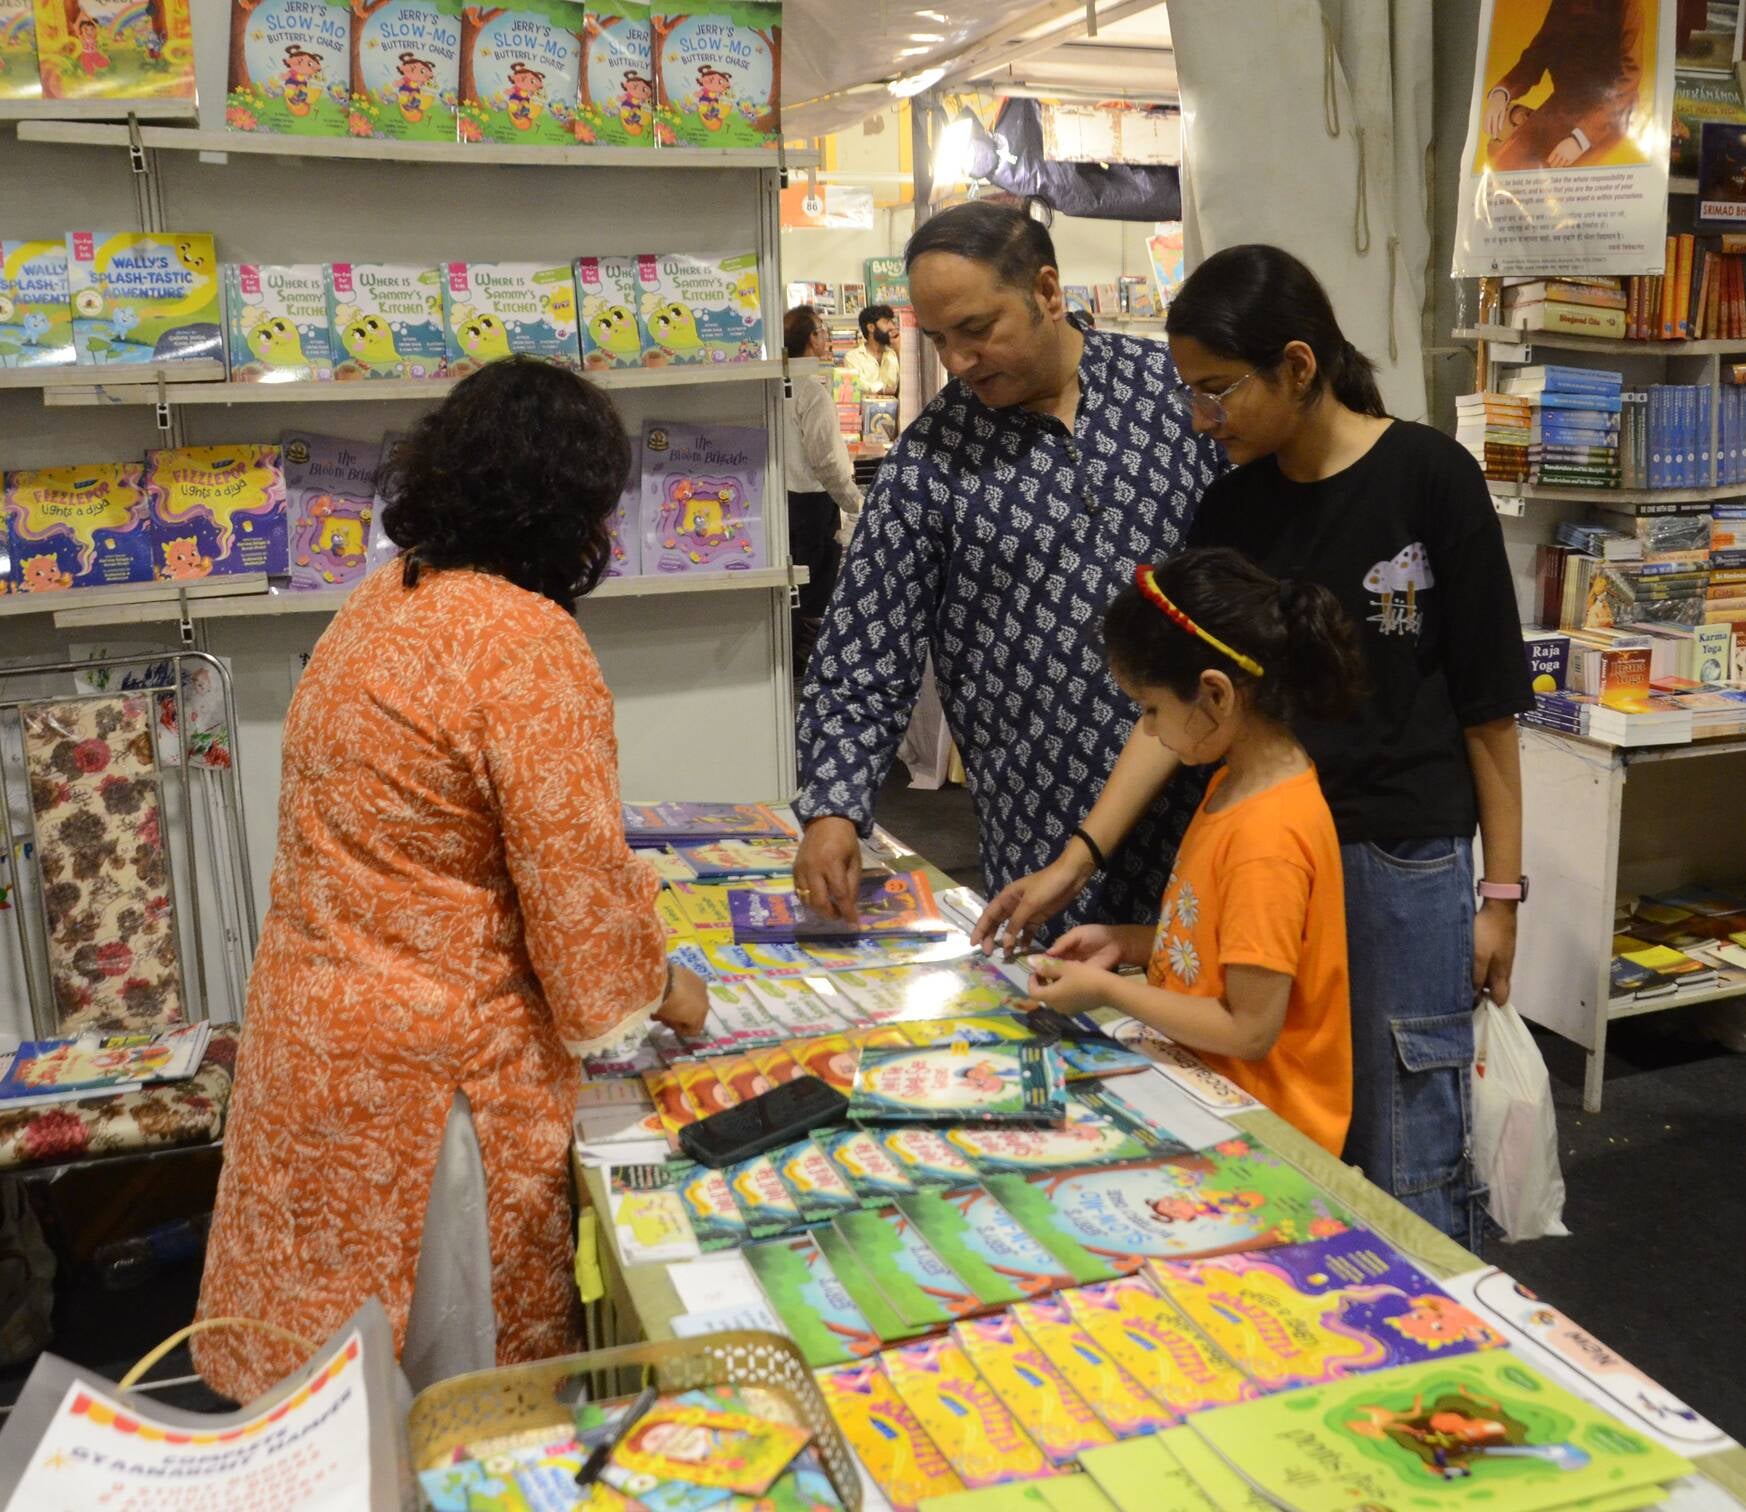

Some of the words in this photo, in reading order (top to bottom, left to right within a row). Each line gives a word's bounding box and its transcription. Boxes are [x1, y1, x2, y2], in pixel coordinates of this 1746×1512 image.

[285, 1, 327, 17] JERRY'S
[398, 10, 438, 24] JERRY'S
[266, 15, 345, 39] SLOW-MO
[380, 23, 456, 46] SLOW-MO
[512, 21, 551, 37] JERRY'S
[696, 24, 734, 37] JERRY'S
[267, 32, 312, 43] BUTTERFLY
[316, 37, 344, 52] CHASE
[381, 40, 425, 51] BUTTERFLY
[429, 44, 455, 60] CHASE
[494, 34, 567, 58] SLOW-MO
[680, 38, 751, 56] SLOW-MO
[495, 50, 536, 62] BUTTERFLY
[540, 56, 566, 71] CHASE
[681, 52, 722, 65] BUTTERFLY
[725, 54, 750, 70] CHASE
[1703, 204, 1734, 216] SRIMAD
[112, 257, 168, 268] WALLY'S
[90, 272, 193, 284] SPLASH-TASTIC
[1700, 632, 1727, 643] Karma
[1532, 645, 1560, 658] Raja
[1702, 644, 1721, 655] Yoga
[1531, 660, 1560, 672] Yoga
